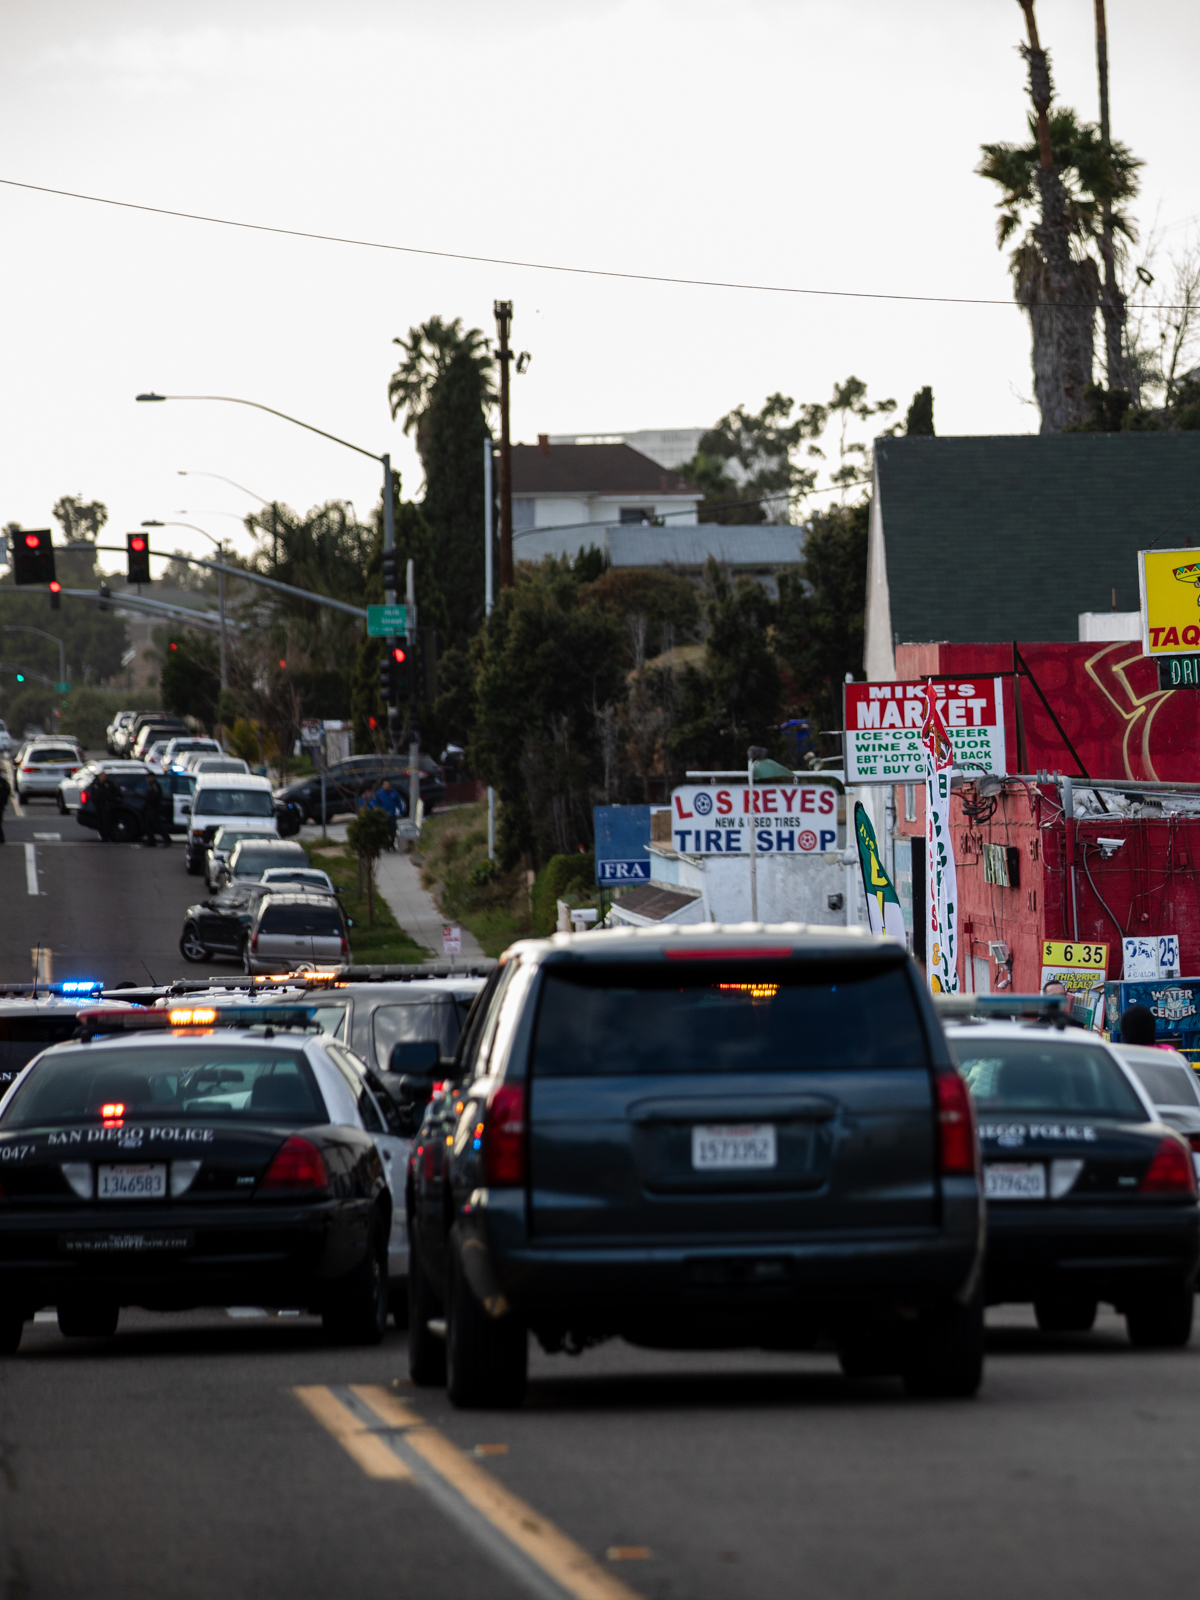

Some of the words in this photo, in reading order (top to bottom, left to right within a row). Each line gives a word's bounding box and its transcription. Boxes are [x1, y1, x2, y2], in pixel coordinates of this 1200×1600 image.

[869, 684, 976, 699] MIKE'S
[856, 698, 987, 729] MARKET
[946, 728, 989, 738] BEER
[856, 742, 901, 752] WINE
[907, 742, 918, 751] &
[960, 751, 992, 760] BACK
[857, 765, 877, 775] WE
[883, 764, 910, 775] BUY
[743, 788, 834, 815] REYES
[715, 817, 735, 828] NEW
[738, 817, 745, 828] &
[748, 817, 771, 828] SED
[774, 816, 801, 828] TIRES
[674, 830, 742, 852] TIRE
[756, 829, 836, 852] SHOP
[1046, 945, 1053, 956] $
[1064, 944, 1103, 964] 6.35
[1056, 972, 1075, 981] THIS
[1076, 972, 1101, 981] PRICE
[1067, 981, 1093, 989] REAL?
[1151, 989, 1194, 1001] WATER
[1150, 1003, 1197, 1019] CENTER
[48, 1129, 83, 1146] SAN
[87, 1127, 145, 1143] DIEGO
[150, 1127, 214, 1142] POLICE
[978, 1123, 1027, 1138] IEGO
[1030, 1123, 1098, 1141] POLICE
[102, 1175, 162, 1194] 1346583
